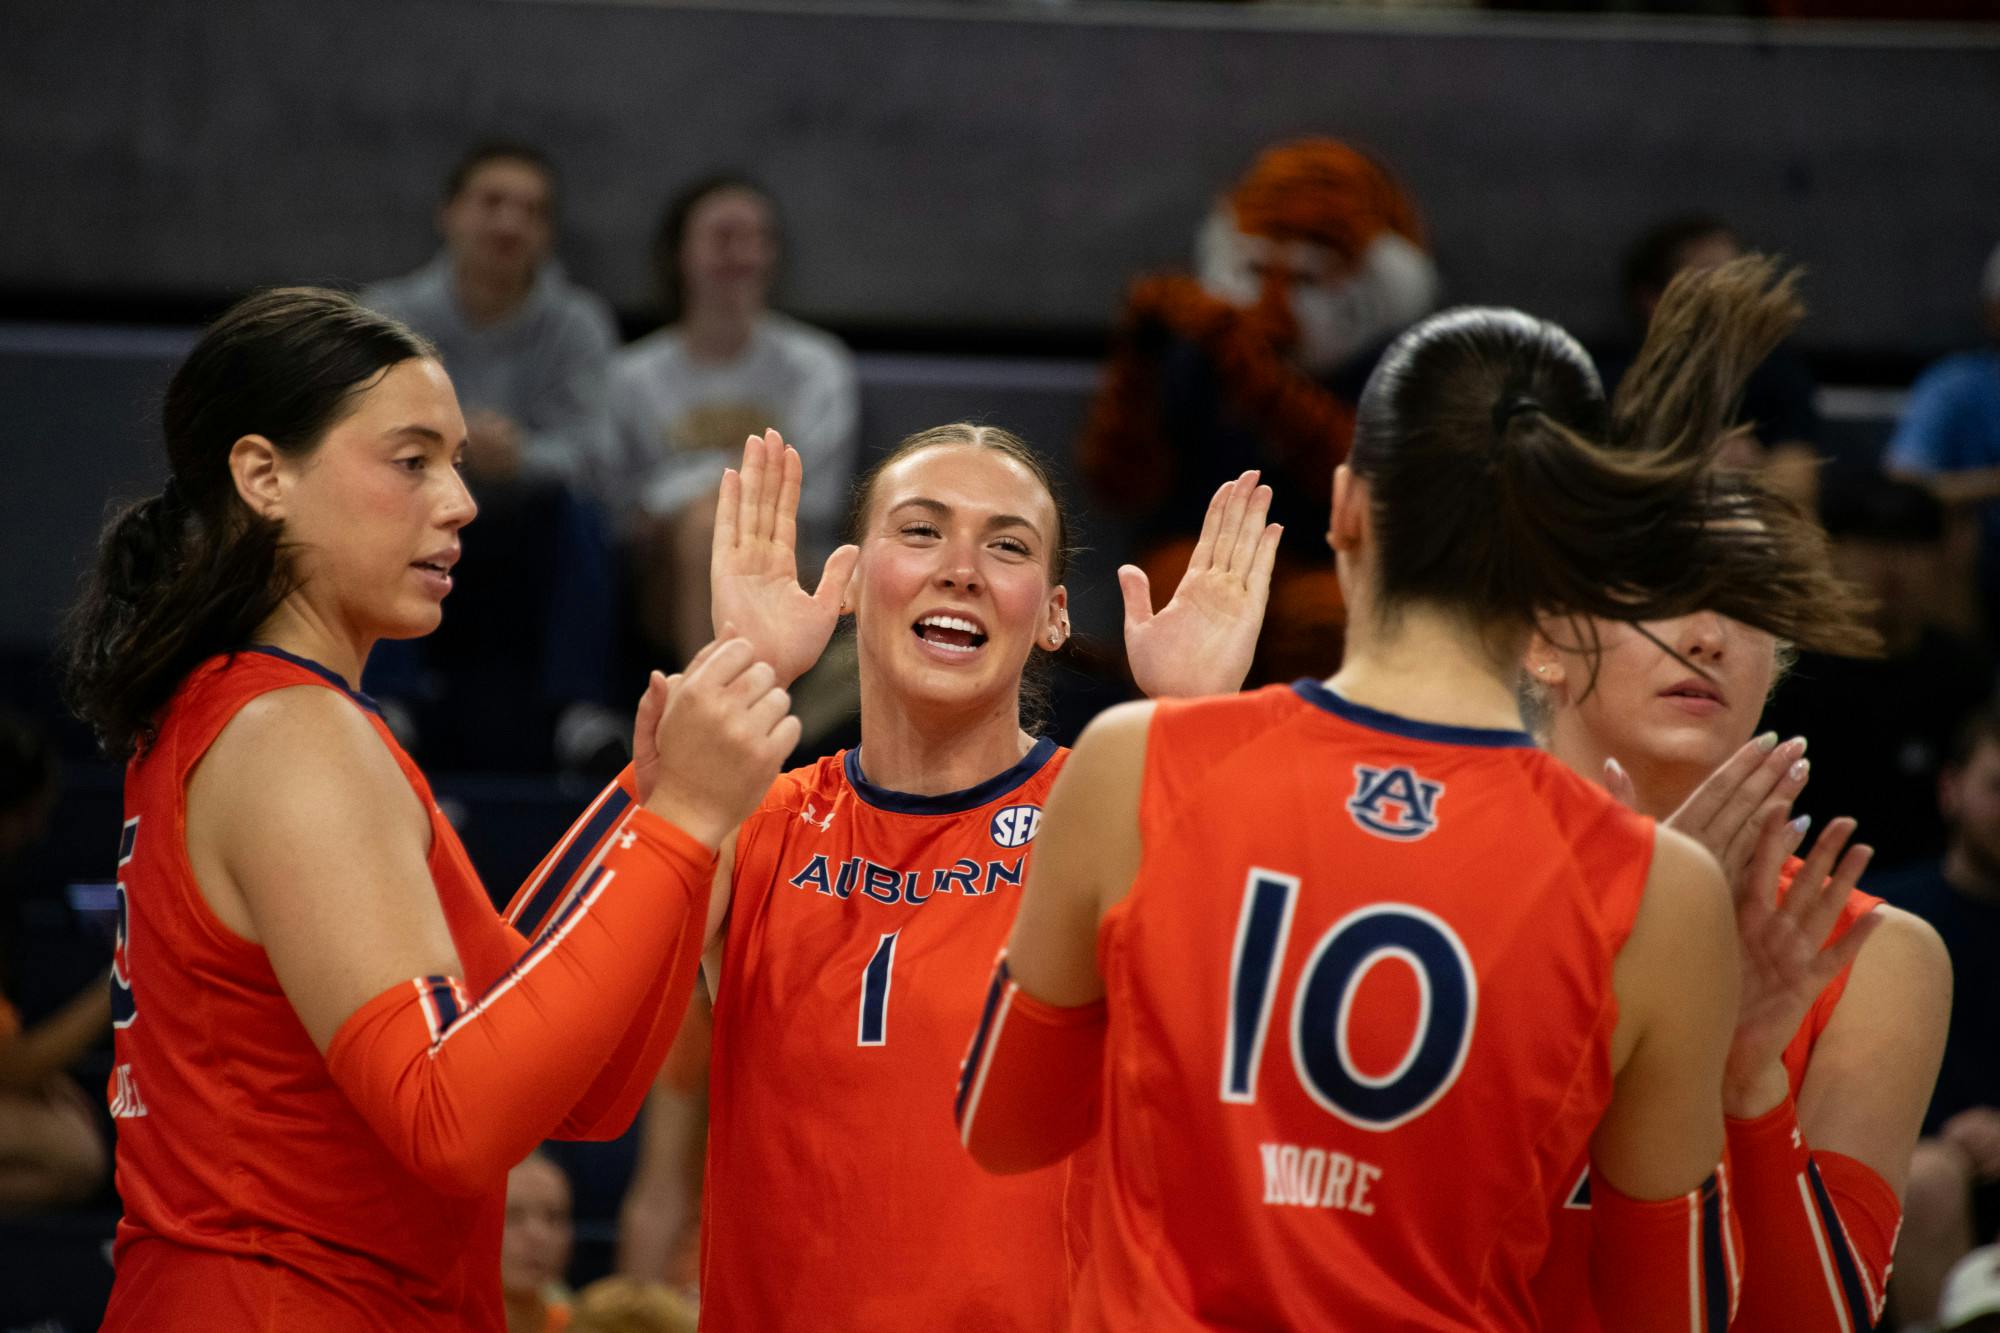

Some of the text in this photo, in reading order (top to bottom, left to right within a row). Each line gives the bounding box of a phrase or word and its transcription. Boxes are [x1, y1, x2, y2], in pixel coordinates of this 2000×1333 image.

[790, 853, 1028, 905] AUBURN
[858, 928, 902, 1047] 1
[1220, 867, 1479, 1132] 10
[1260, 1142, 1383, 1216] MOORE
